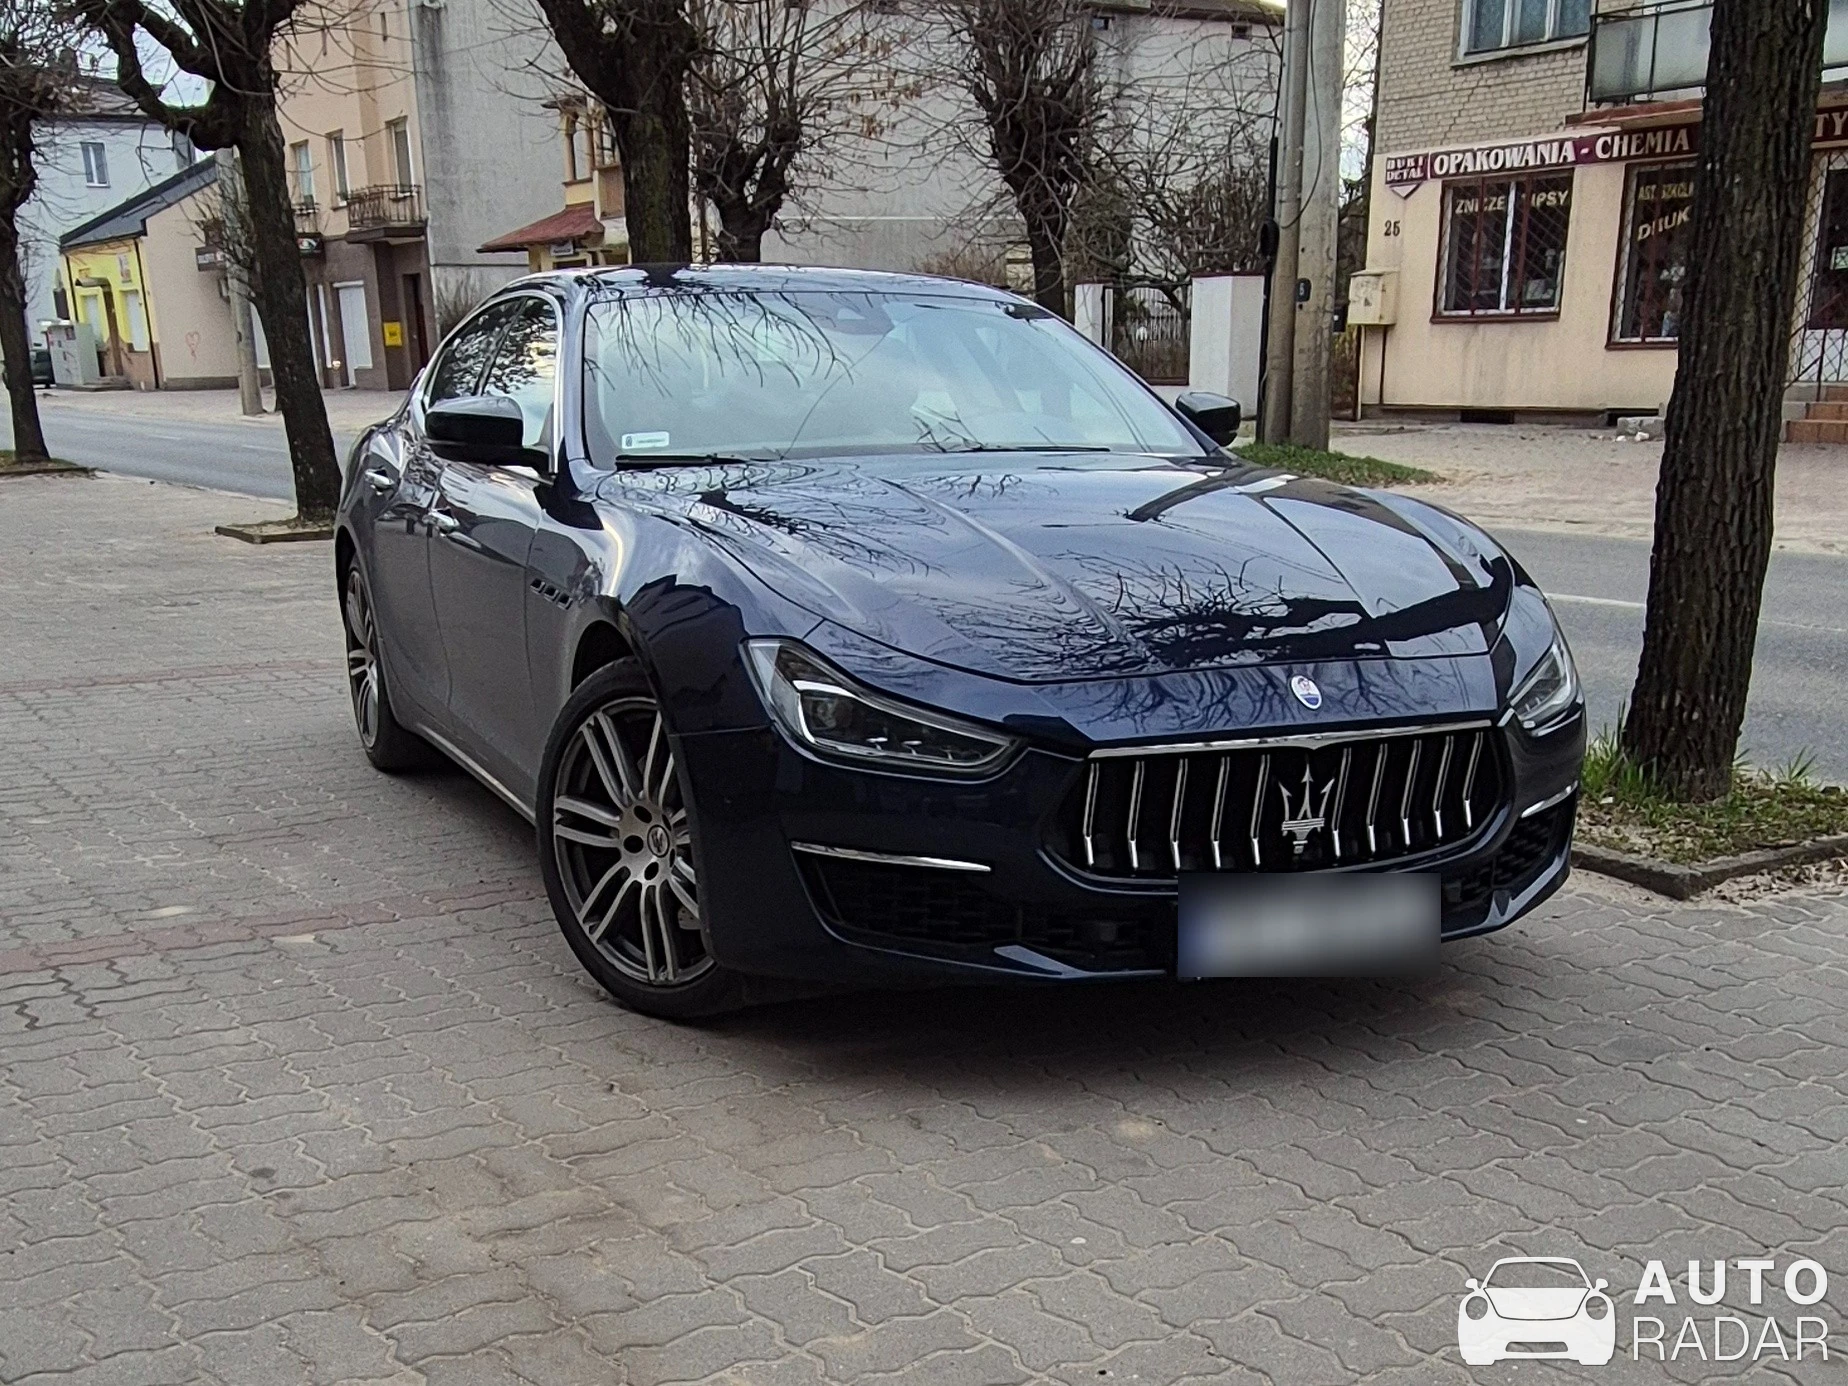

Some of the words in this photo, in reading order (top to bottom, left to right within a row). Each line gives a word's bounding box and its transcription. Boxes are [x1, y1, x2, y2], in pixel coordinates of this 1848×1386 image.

[1433, 141, 1577, 175] OPAKOWANIA
[1595, 128, 1690, 159] CHEMIA
[1521, 189, 1569, 209] IPSY
[1384, 219, 1401, 237] 25
